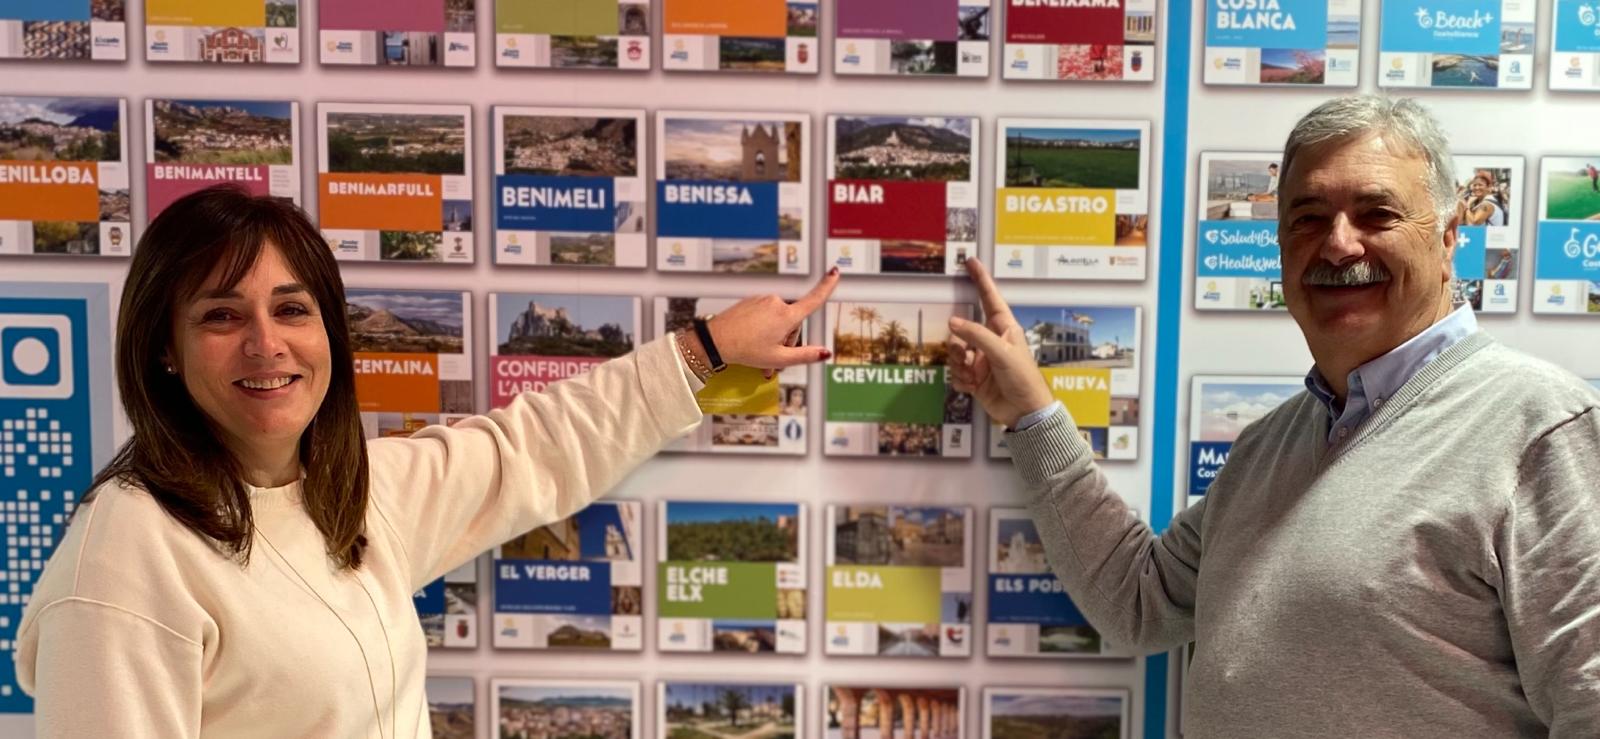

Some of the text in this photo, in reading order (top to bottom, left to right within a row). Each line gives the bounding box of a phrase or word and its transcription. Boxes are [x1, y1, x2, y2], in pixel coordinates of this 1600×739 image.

[1216, 0, 1280, 10] COSTA
[1216, 11, 1297, 31] BLANCA
[1435, 9, 1494, 29] Beach+
[0, 165, 95, 184] ENILLOBA
[154, 165, 263, 181] BENIMANTELL
[328, 181, 434, 197] BENIMARFULL
[502, 186, 605, 210] BENIMELI
[664, 184, 754, 205] BENISSA
[833, 183, 884, 204] BIAR
[1005, 195, 1109, 214] BIGASTRO
[354, 359, 434, 376] CENTAINA
[831, 367, 937, 385] CREVILLENT
[1052, 375, 1108, 391] NUEVA
[500, 565, 591, 582] EL VERGER
[666, 567, 728, 585] ELCHE
[832, 570, 883, 589] ELDA
[666, 585, 704, 602] ELX
[995, 578, 1065, 594] ELS POB
